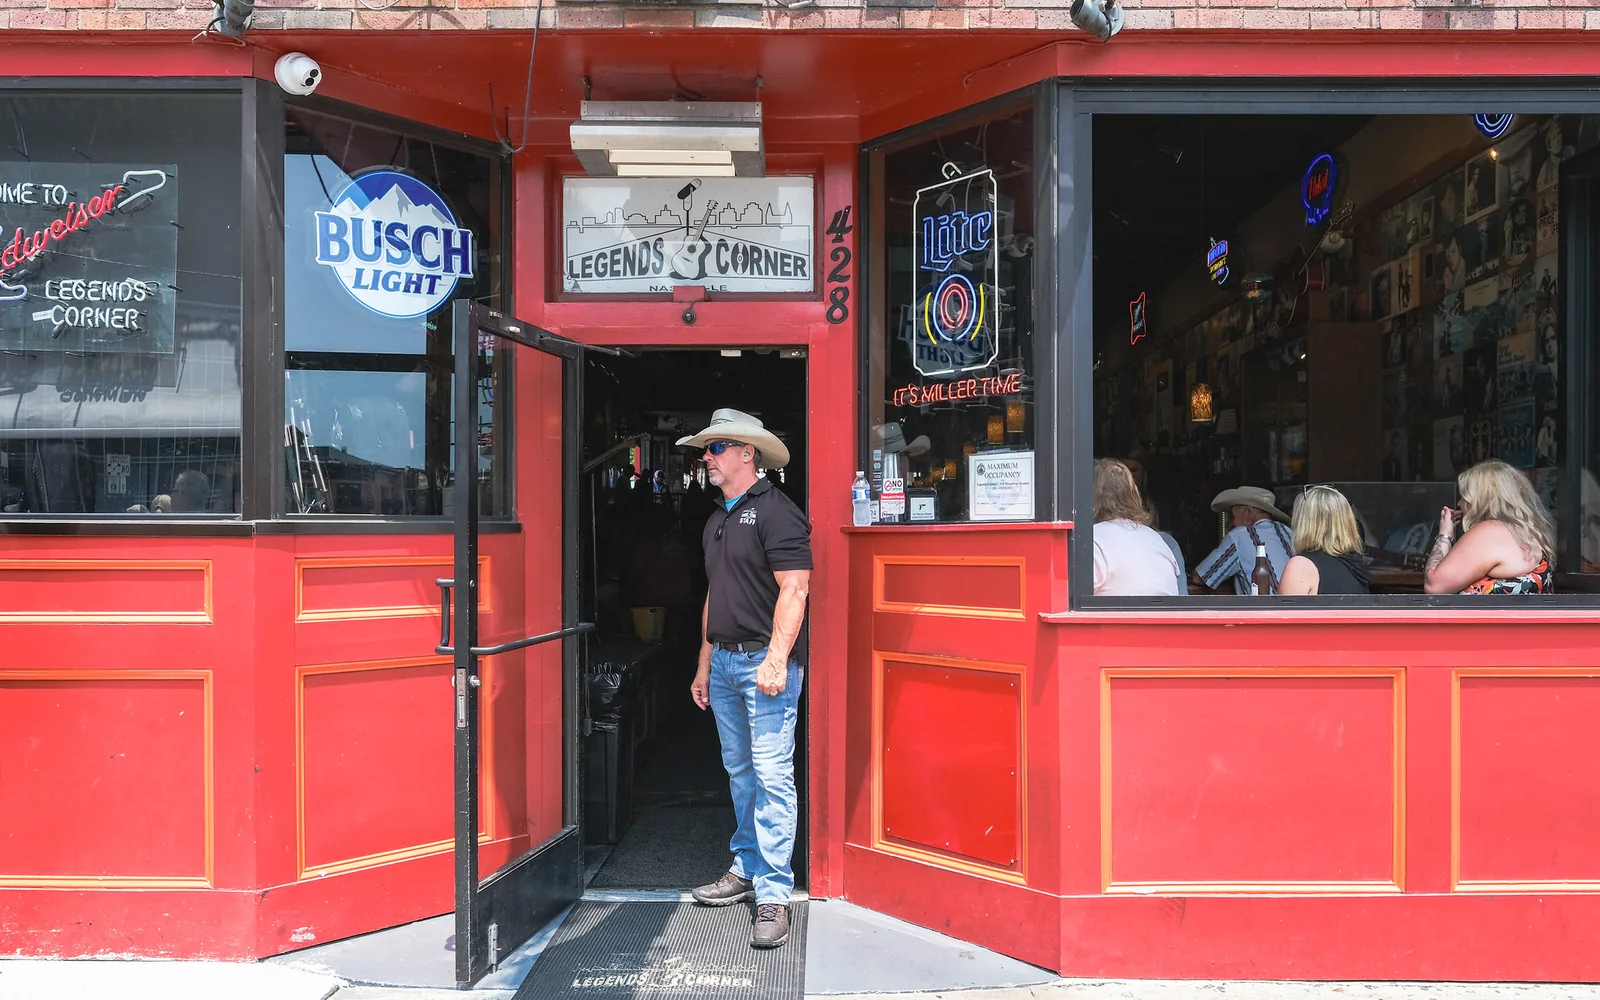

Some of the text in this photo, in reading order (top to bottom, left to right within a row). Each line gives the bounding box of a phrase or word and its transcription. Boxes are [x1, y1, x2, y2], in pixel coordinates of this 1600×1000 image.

[42, 184, 67, 205] TO
[315, 212, 473, 277] BUSCH
[920, 211, 993, 272] Lite
[569, 237, 807, 278] LEGENDS CORNER
[825, 205, 853, 325] 428
[45, 280, 147, 301] LEGENDS
[352, 267, 442, 295] LIGHT
[51, 305, 140, 328] CORNER
[893, 373, 1021, 406] IT'S MILLER TIME
[984, 471, 1022, 479] OCCUPANCY
[987, 462, 1018, 470] MAXIMUM
[739, 517, 756, 525] STAFF
[572, 971, 754, 988] LEGENDS CORNER
